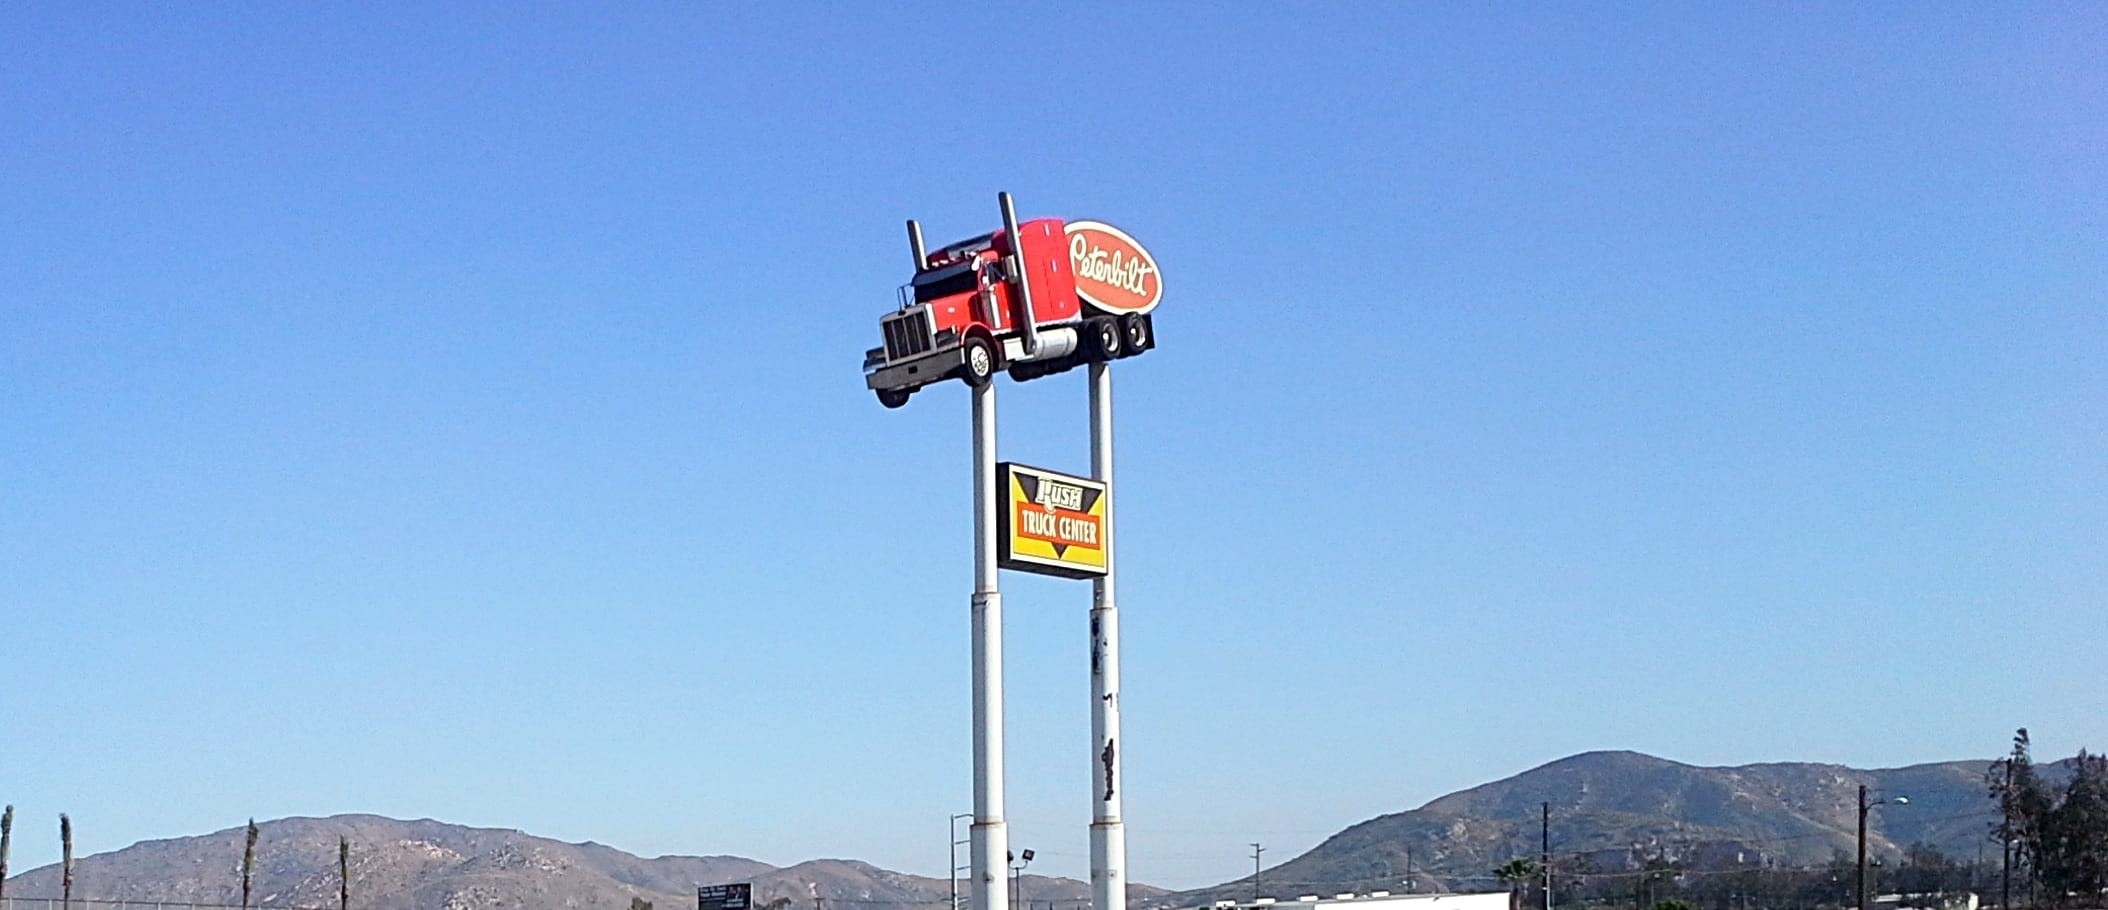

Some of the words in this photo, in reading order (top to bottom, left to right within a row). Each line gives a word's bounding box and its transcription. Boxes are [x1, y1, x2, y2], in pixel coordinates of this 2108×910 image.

[1069, 233, 1153, 297] Peterbilt
[1035, 477, 1083, 512] RUSH
[1022, 509, 1057, 538] TRUCK
[1059, 516, 1097, 544] CENTER
